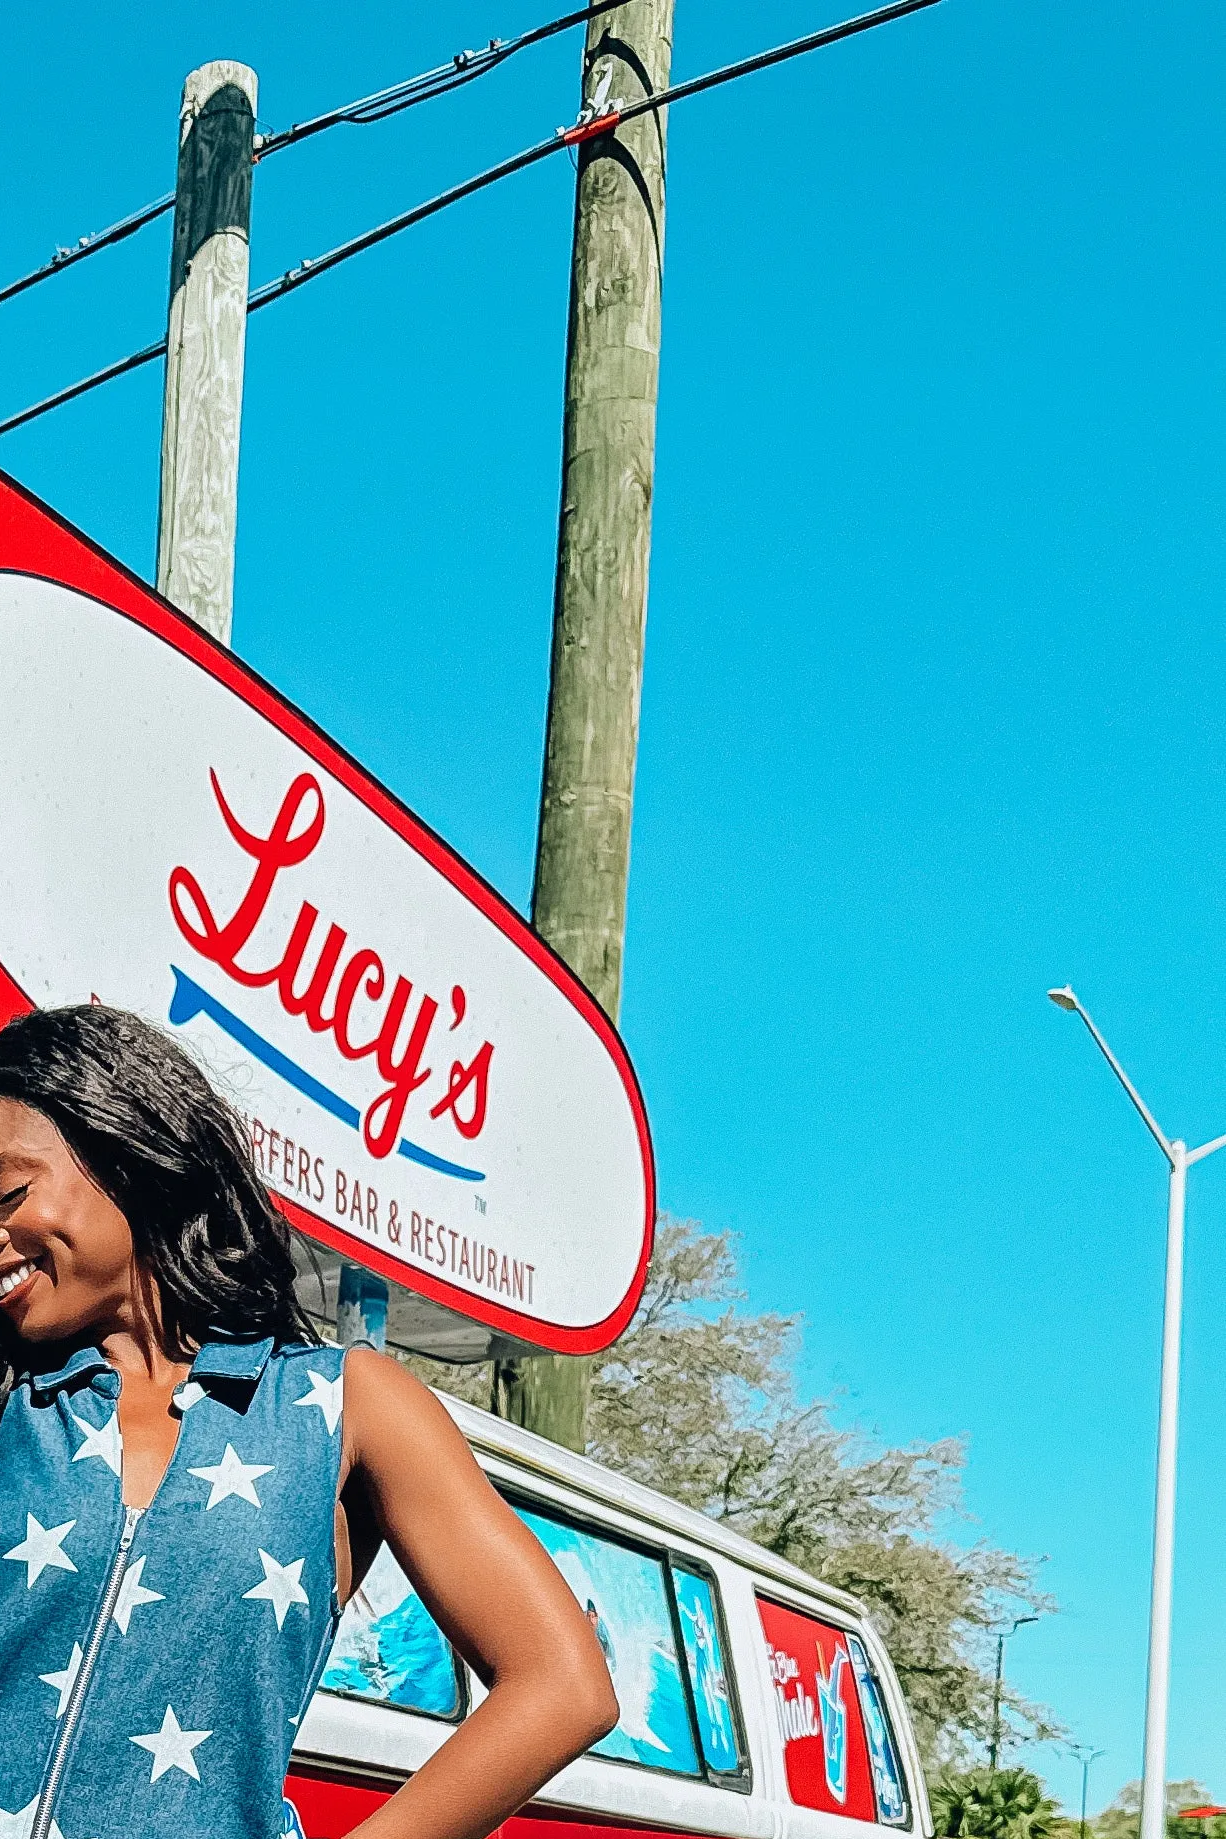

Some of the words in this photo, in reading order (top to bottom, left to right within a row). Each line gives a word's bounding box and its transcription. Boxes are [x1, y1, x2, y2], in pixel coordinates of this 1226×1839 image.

[168, 766, 495, 1159] Lucy's
[252, 1117, 325, 1203] RFERS
[334, 1168, 379, 1235] BAR
[387, 1199, 402, 1247] &
[410, 1210, 536, 1305] RESTAURANT
